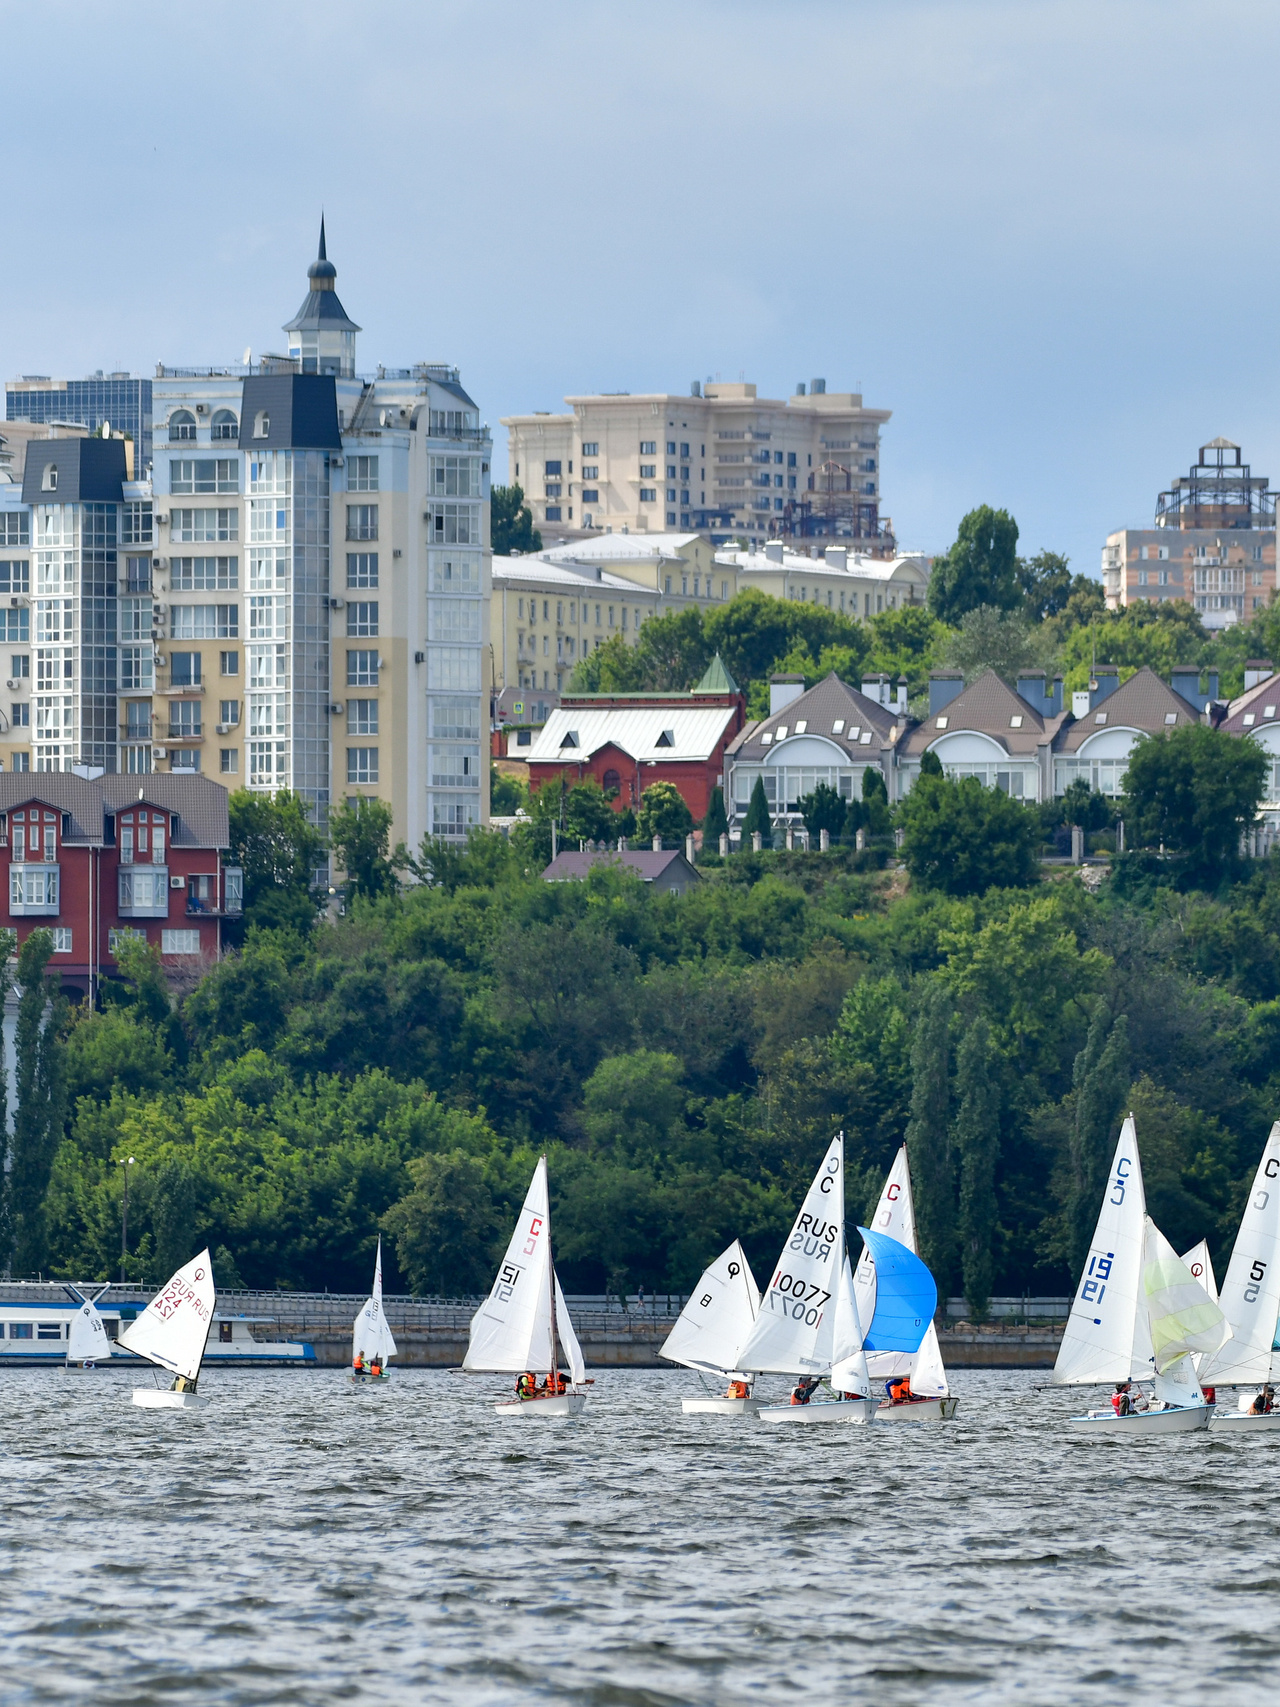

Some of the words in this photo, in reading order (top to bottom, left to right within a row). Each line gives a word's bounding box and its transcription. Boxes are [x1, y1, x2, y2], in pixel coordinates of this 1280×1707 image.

[1117, 1158, 1132, 1178] C
[1265, 1159, 1280, 1179] C
[820, 1176, 834, 1193] C
[887, 1184, 901, 1201] C
[530, 1218, 543, 1237] C
[797, 1213, 838, 1243] RUS
[1088, 1256, 1113, 1281] 19
[1250, 1260, 1267, 1281] 5
[162, 1287, 183, 1309] 124
[773, 1271, 832, 1308] 10077
[191, 1298, 210, 1322] RUS
